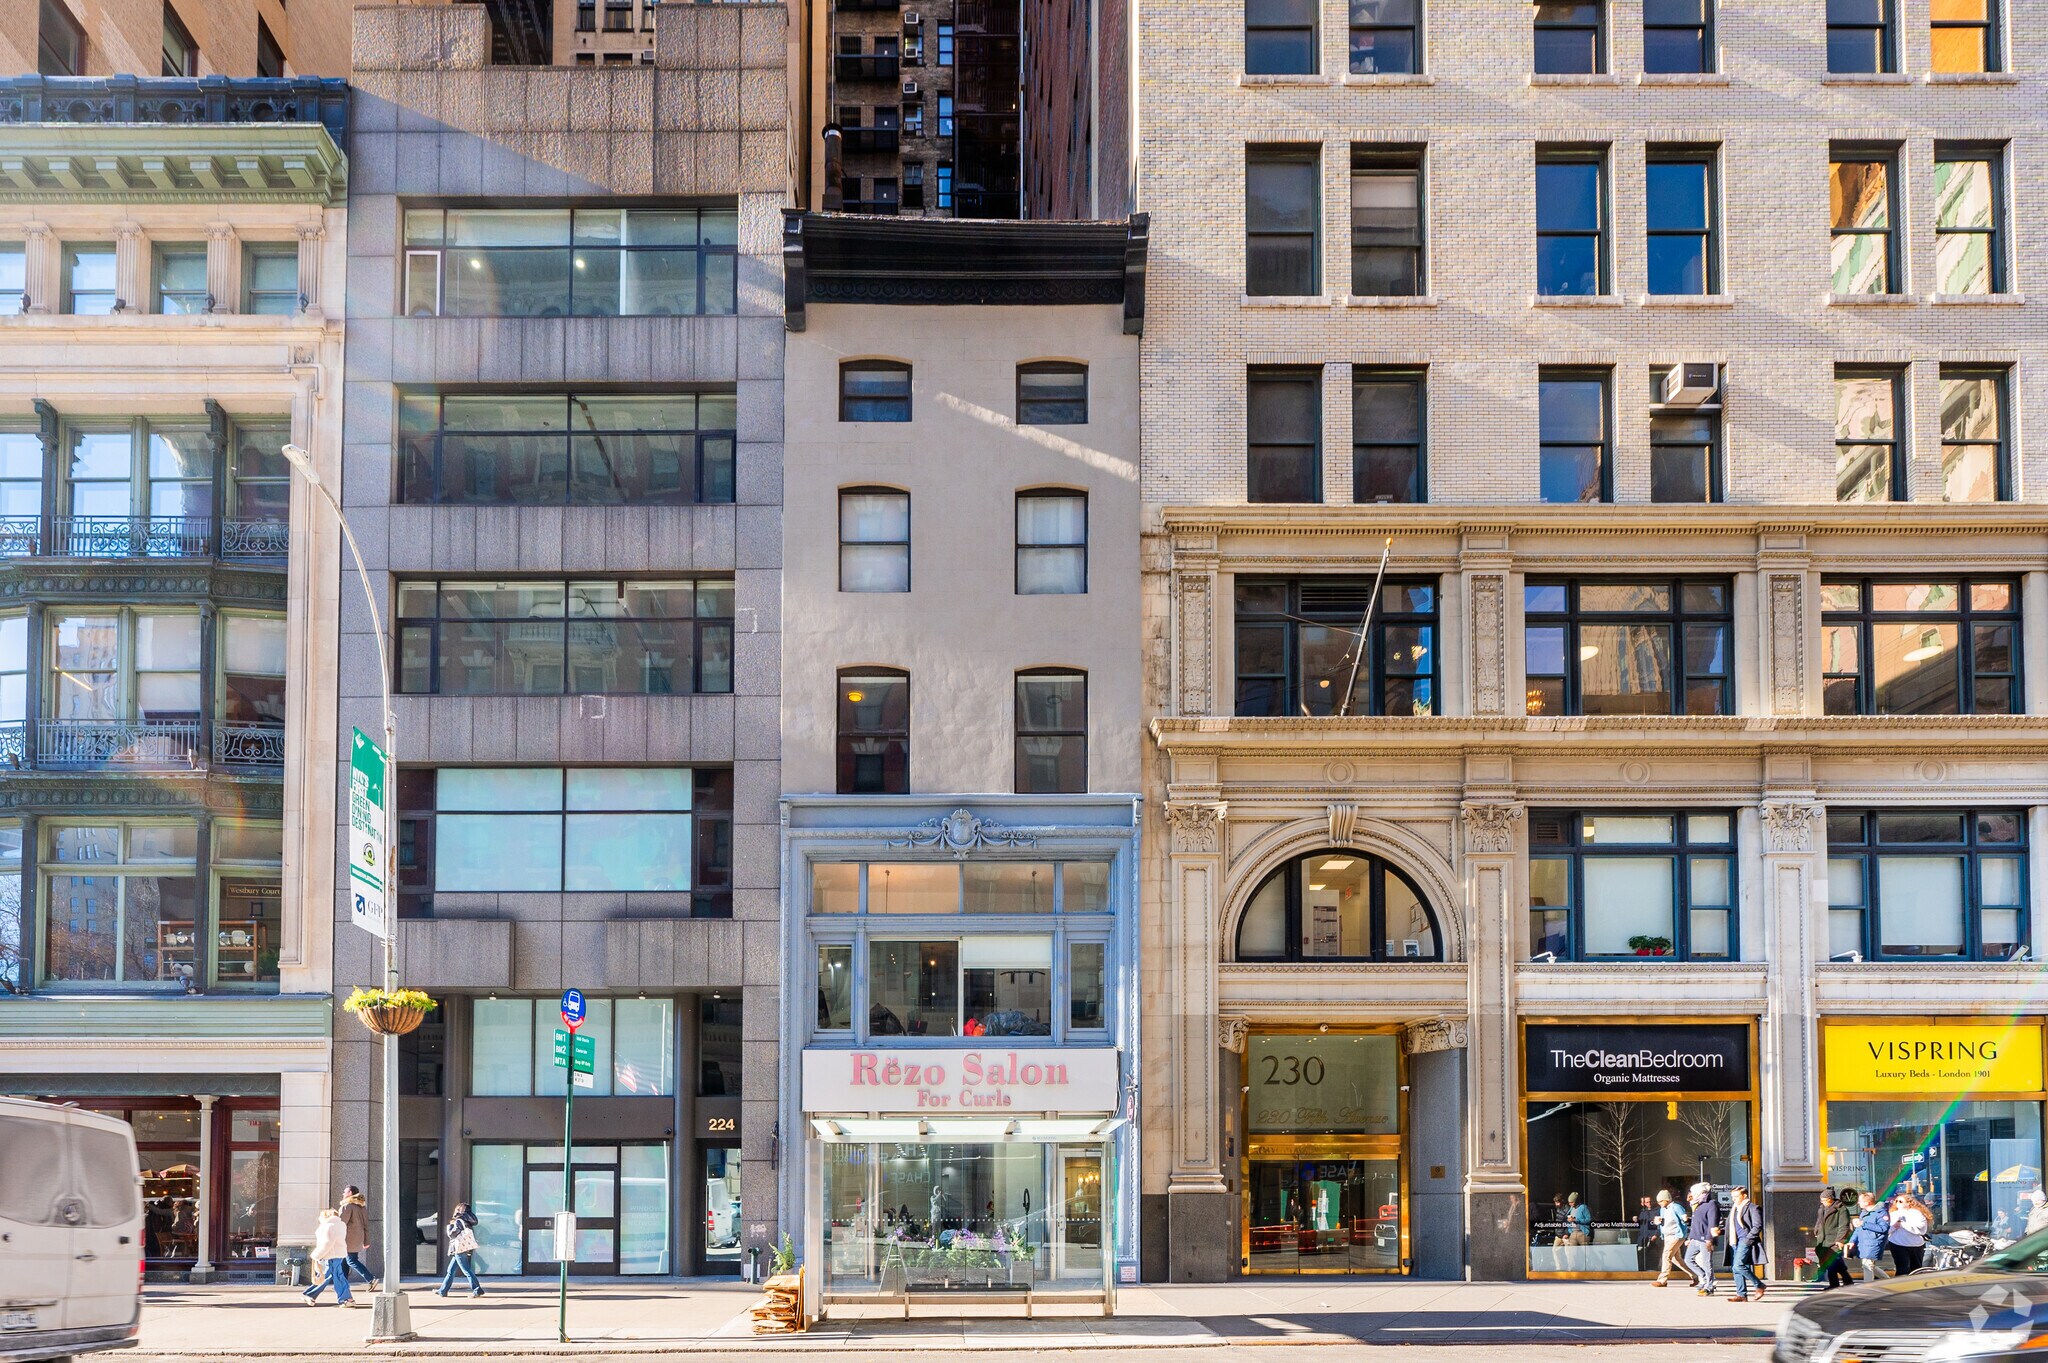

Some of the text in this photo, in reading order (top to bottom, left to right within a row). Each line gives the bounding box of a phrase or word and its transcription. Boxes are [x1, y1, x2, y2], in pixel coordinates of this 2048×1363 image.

[230, 887, 280, 896] Westbury Court
[1867, 1041, 1997, 1060] VISPRING
[555, 1057, 567, 1066] MTA
[1550, 1050, 1723, 1068] TheCleanBedroom
[850, 1051, 1069, 1087] Rëzo Salon
[1261, 1055, 1325, 1086] 230
[1875, 1070, 1907, 1080] Luxury
[1909, 1070, 1930, 1078] Beds
[1938, 1070, 1971, 1078] London
[1593, 1073, 1681, 1085] Organic Mattresses
[917, 1088, 1012, 1107] For Curls
[1256, 1109, 1291, 1125] 230
[1333, 1107, 1389, 1125] Avenue
[709, 1118, 735, 1131] 224
[1534, 1221, 1561, 1229] Adjustable
[1590, 1221, 1611, 1229] Organic
